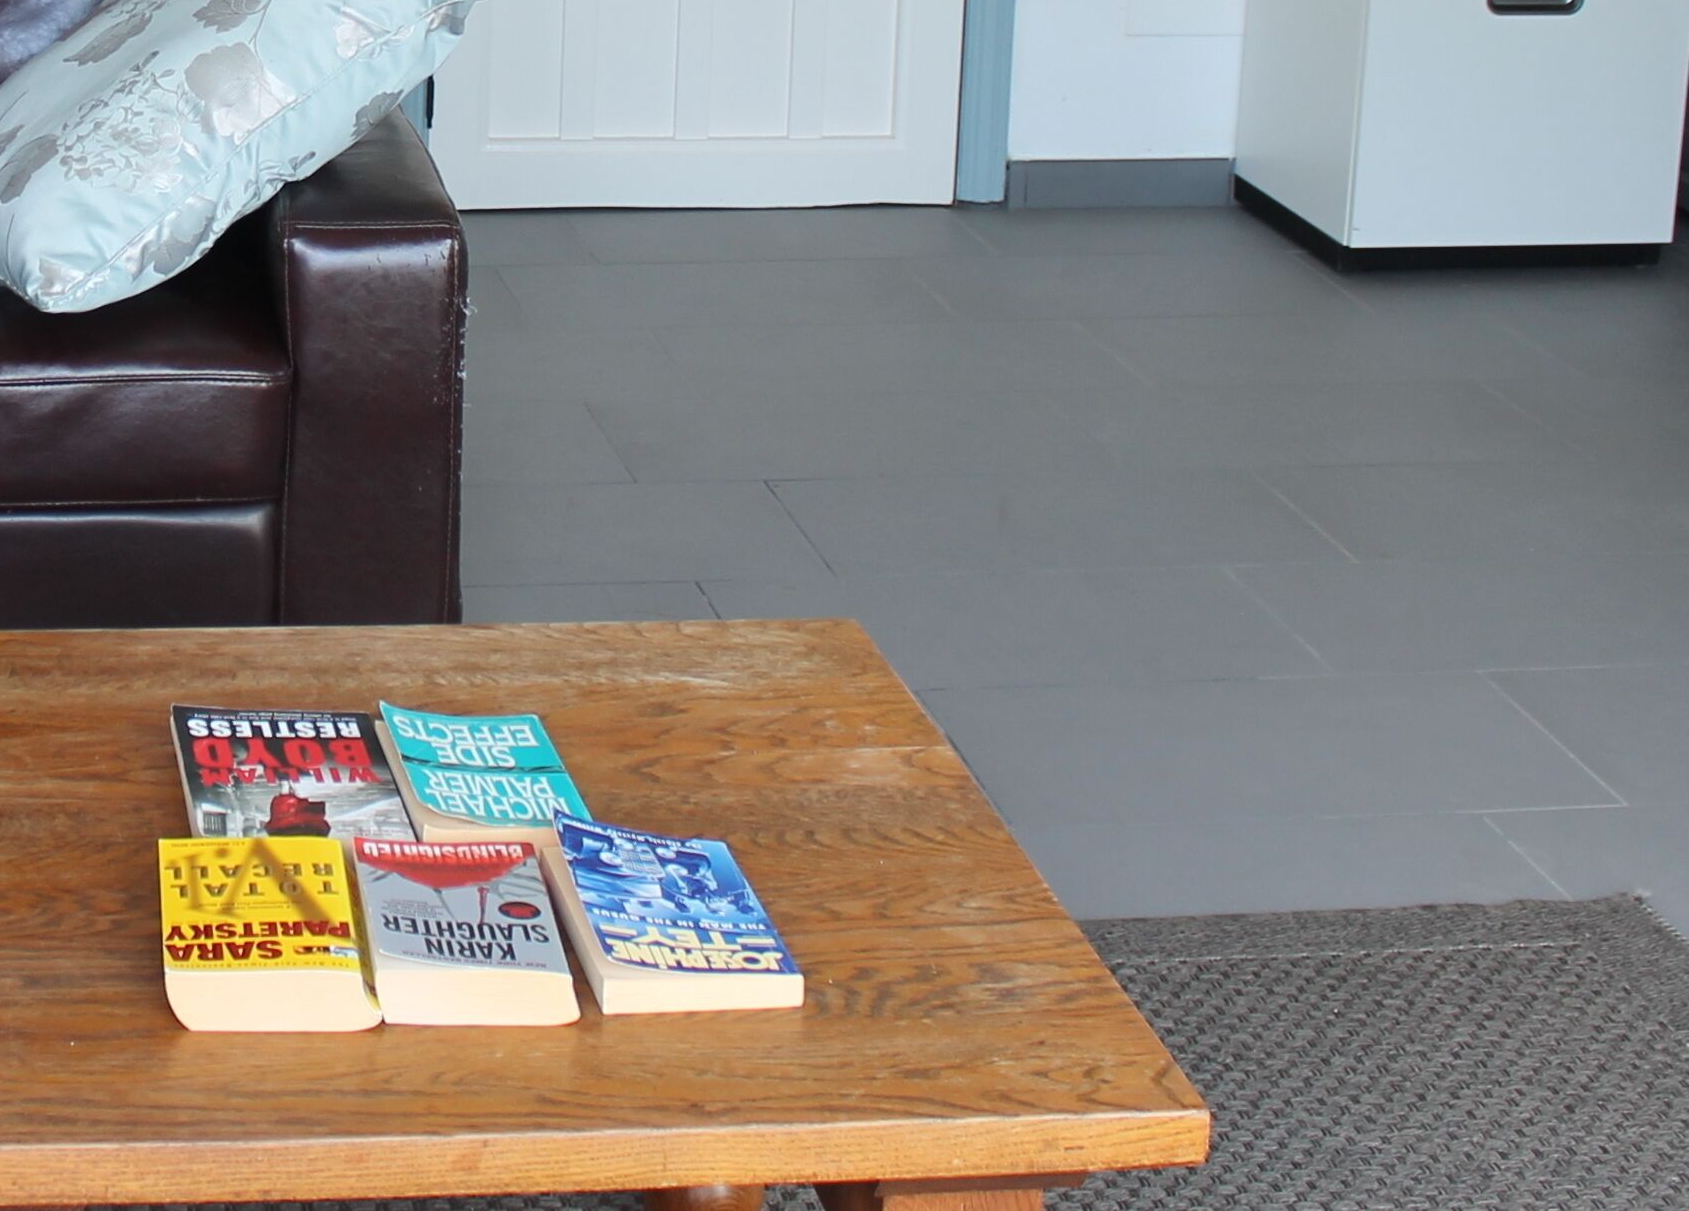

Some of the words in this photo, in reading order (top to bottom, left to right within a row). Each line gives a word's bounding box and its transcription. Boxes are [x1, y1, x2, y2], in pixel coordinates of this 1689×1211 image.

[187, 719, 361, 738] RESTLESS
[393, 715, 538, 747] EFFECTS
[192, 738, 372, 768] BOYD
[431, 742, 516, 767] SIDE
[199, 767, 381, 787] WILLIAM
[423, 769, 554, 797] PALMER
[425, 788, 570, 821] MICHAEL
[363, 842, 523, 864] BLINDSIGHTED
[163, 863, 334, 880] RECALL
[170, 880, 338, 897] TOTAL
[165, 920, 351, 941] PARETSKY
[381, 914, 549, 943] SLAUGHTER
[646, 915, 672, 927] THE
[677, 918, 694, 929] IN
[699, 919, 733, 930] MAN
[740, 922, 766, 931] THE
[424, 938, 516, 961] KARIN
[631, 928, 741, 950] TEY
[165, 940, 283, 961] SARA
